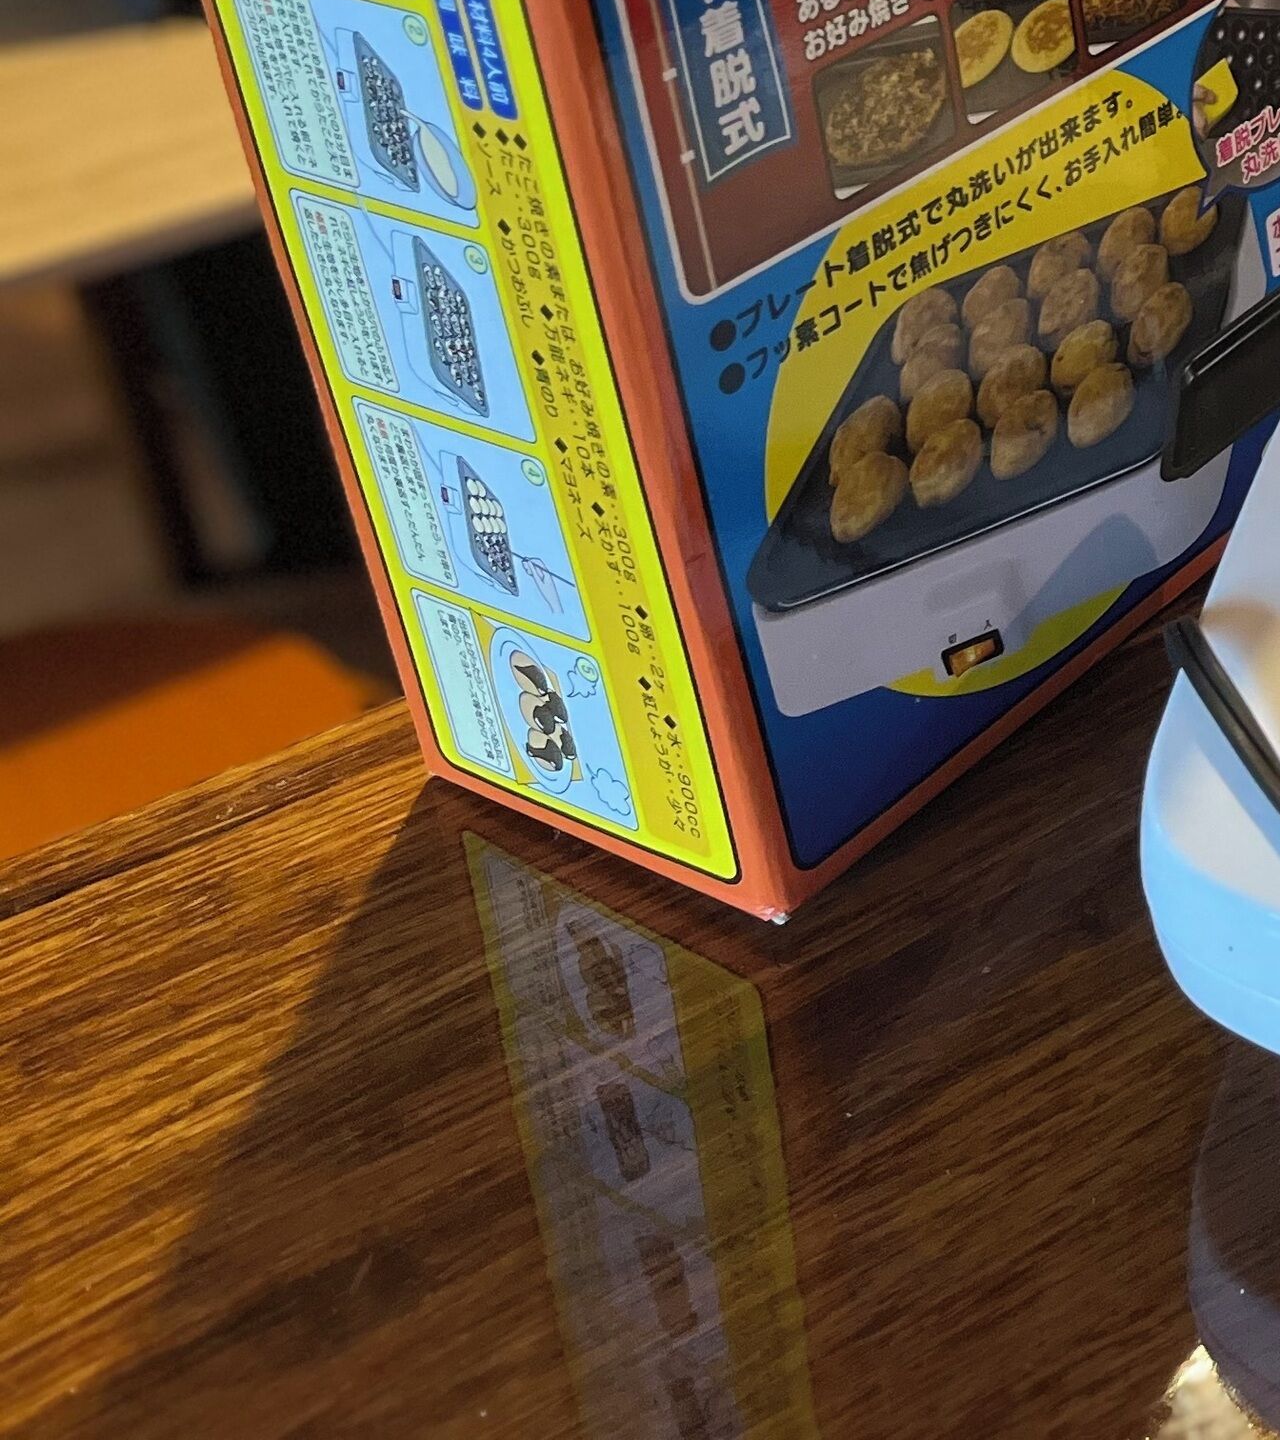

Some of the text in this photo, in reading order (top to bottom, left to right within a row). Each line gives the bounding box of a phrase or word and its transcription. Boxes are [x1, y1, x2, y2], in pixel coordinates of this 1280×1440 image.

[474, 139, 594, 543] ソース かつおぶし 青のり マヨネーズ
[739, 91, 1134, 341] プレート着脱式で丸洗いが出来ます。
